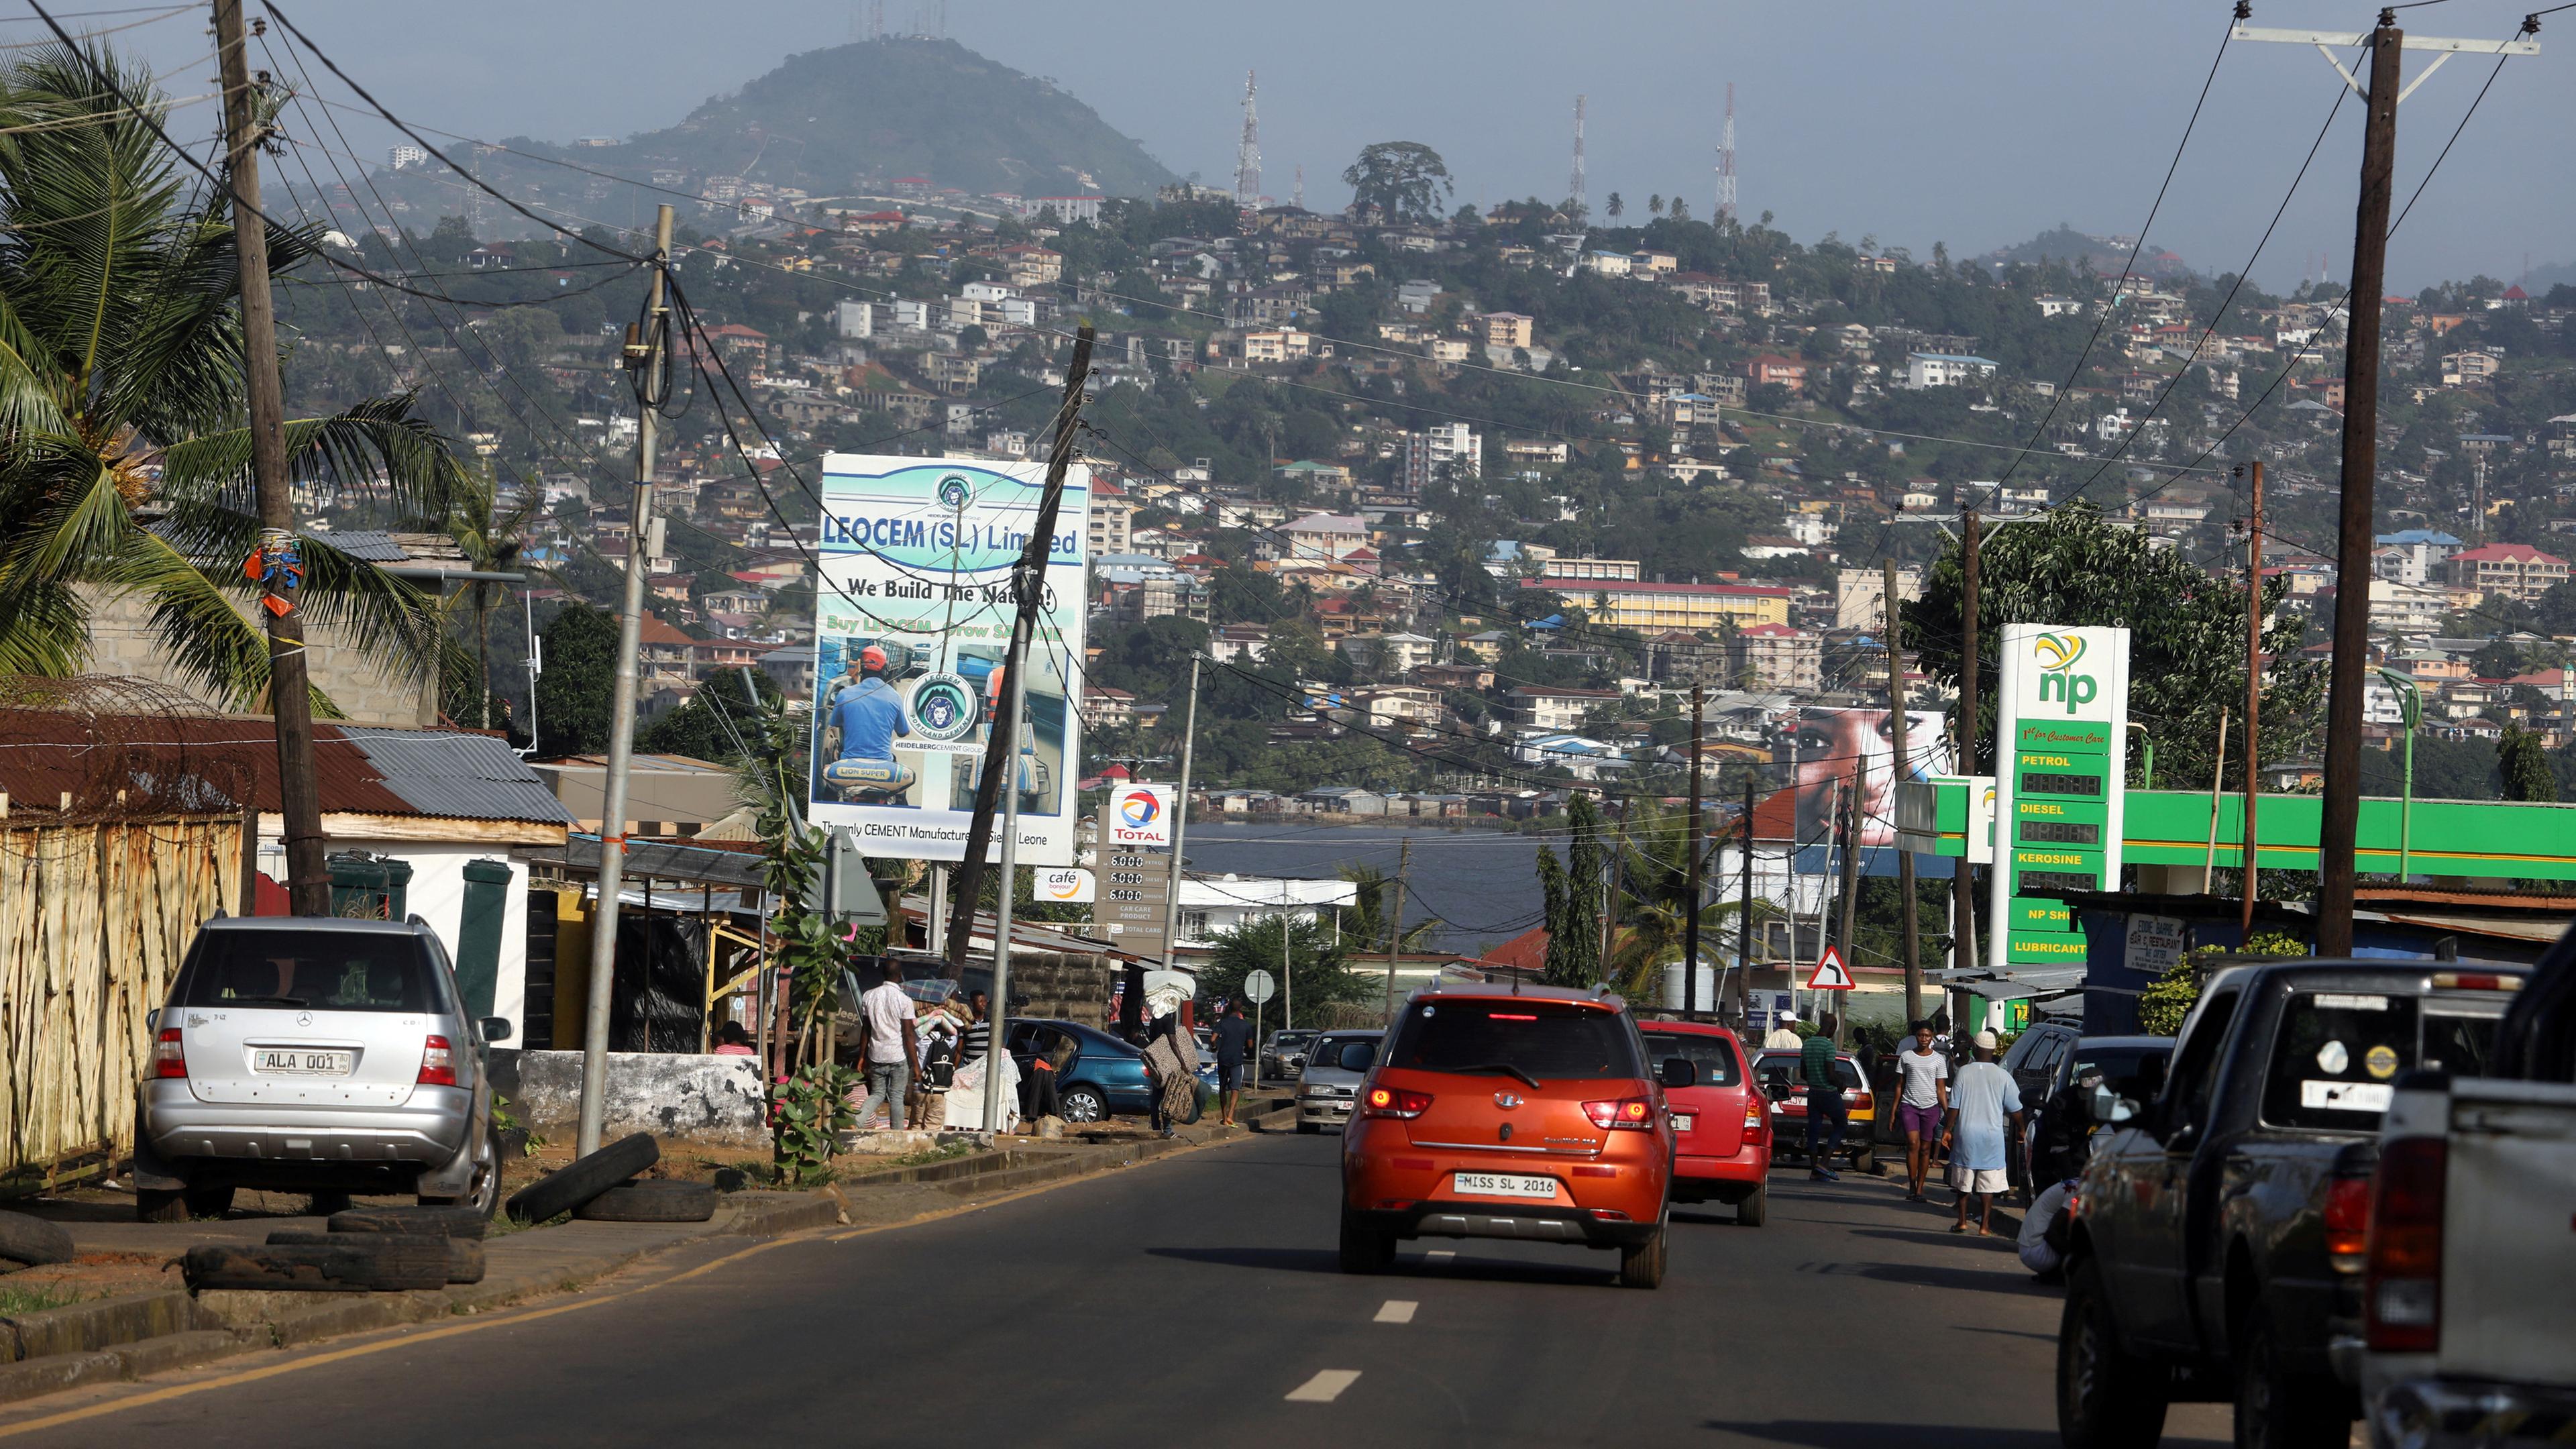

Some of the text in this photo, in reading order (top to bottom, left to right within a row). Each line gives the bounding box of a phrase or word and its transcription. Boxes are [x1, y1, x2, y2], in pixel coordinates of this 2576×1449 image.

[824, 516, 1077, 555] LEOCEM (SL) Limed
[847, 578, 877, 596] We
[885, 580, 932, 600] Build
[941, 583, 974, 602] The
[827, 615, 1063, 643] Buy LEOCEM, Grow SAONE
[924, 674, 961, 686] LEOCEM
[2039, 673, 2098, 714] np
[910, 714, 972, 739] PORTLAND CEMENT
[2023, 727, 2104, 744] 1st for Customer Care
[896, 742, 983, 753] HEIDELBERGCEMENT Group
[2022, 755, 2071, 767] PETROL
[2020, 804, 2064, 815] DIESEL
[864, 823, 907, 838] CEMENT
[1018, 832, 1048, 846] Leone
[1114, 828, 1165, 841] TOTAL
[1111, 856, 1143, 867] 6.000
[2018, 853, 2082, 865] KEROSINE
[1049, 871, 1076, 884] café
[1110, 873, 1143, 884] 6.000
[1109, 890, 1142, 901] 6.000
[2028, 910, 2045, 919] NP
[2130, 933, 2141, 945] BAR
[836, 1007, 859, 1022] Jeep
[266, 1053, 335, 1070] ALA 001
[1787, 1097, 1803, 1106] AJY
[1464, 1176, 1554, 1192] MISS SL 2016
